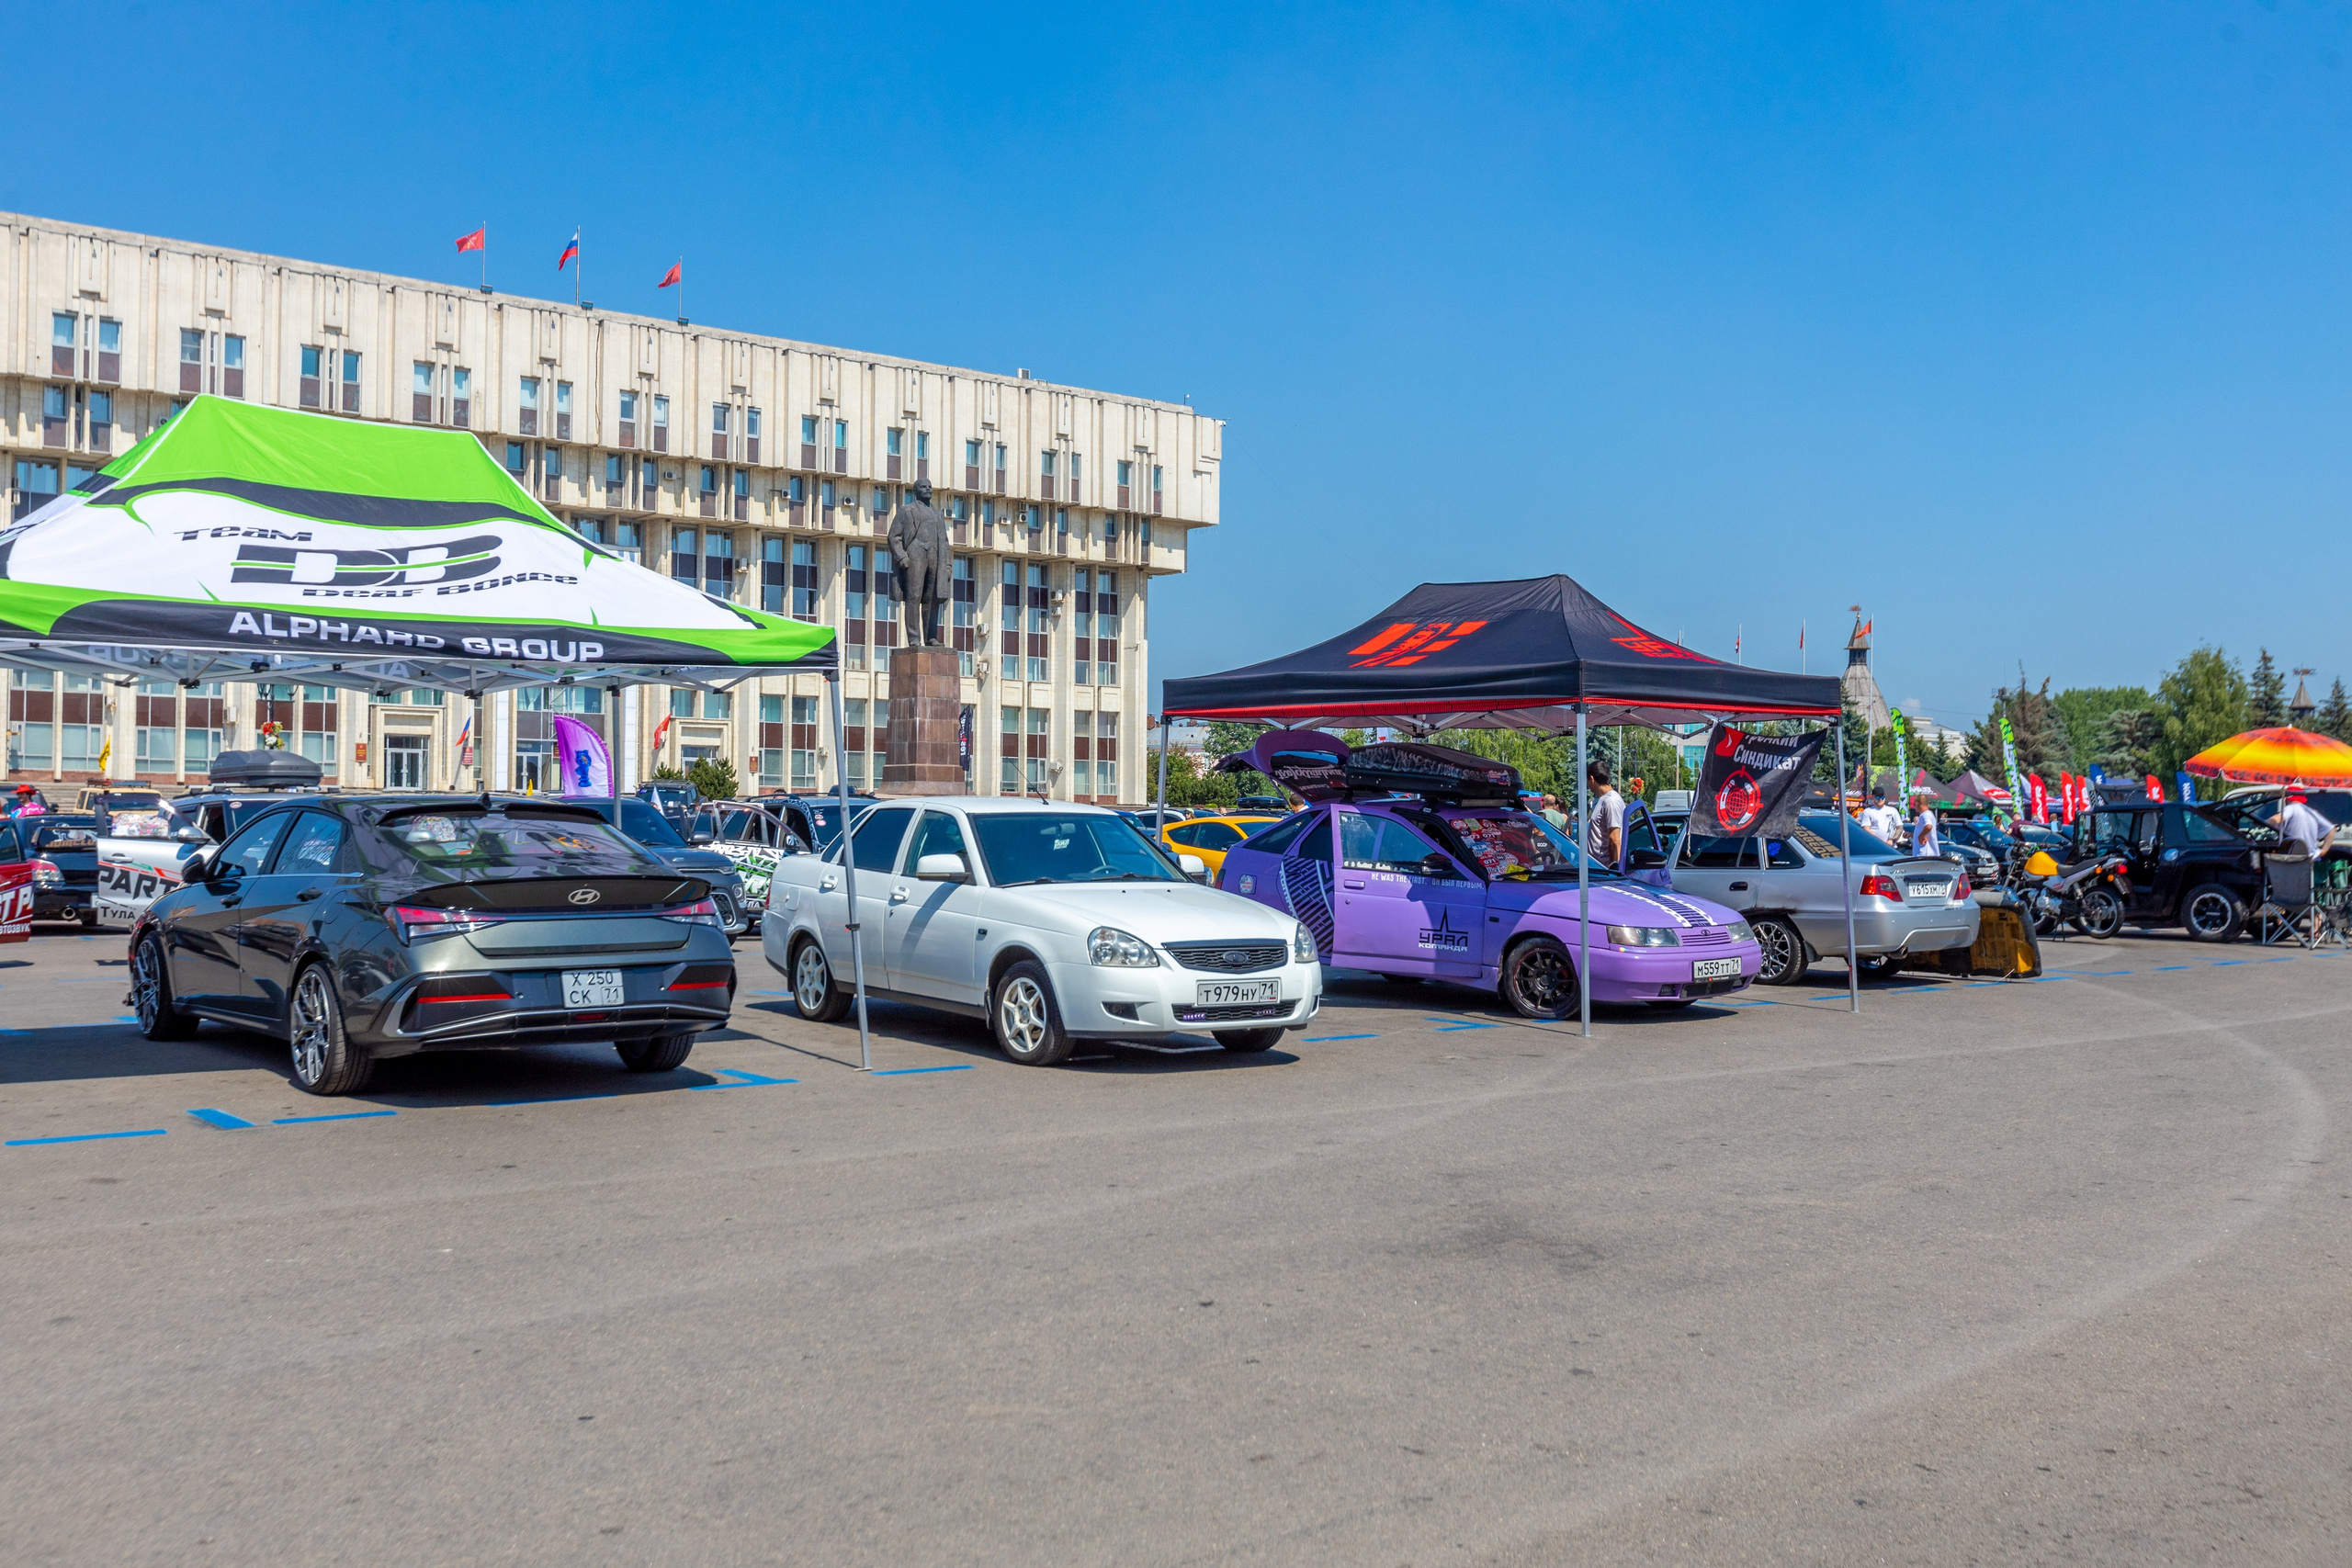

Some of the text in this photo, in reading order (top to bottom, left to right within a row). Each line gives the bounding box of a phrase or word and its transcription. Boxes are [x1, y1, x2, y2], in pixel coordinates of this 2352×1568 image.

[229, 611, 605, 663] ALPHARD GROUP
[1734, 744, 1801, 771] Синдикат
[1381, 874, 1394, 882] WAS
[1396, 874, 1408, 883] THE
[1419, 932, 1468, 947] УРАЛ
[588, 971, 614, 986] 250
[570, 987, 619, 1004] СК 71
[1261, 983, 1273, 996] 71
